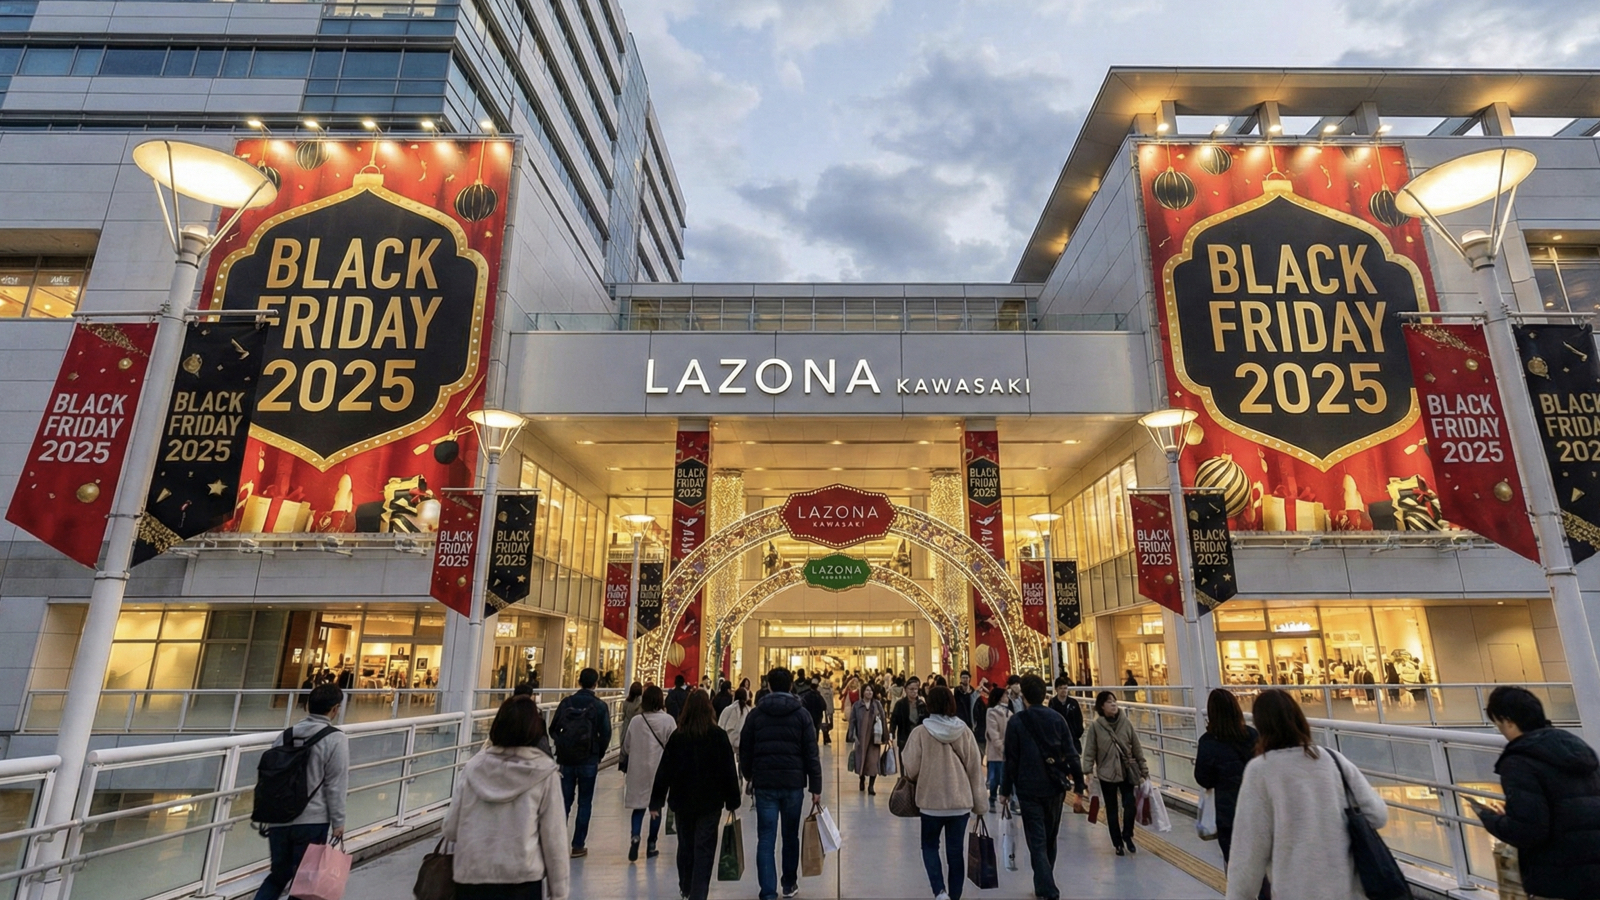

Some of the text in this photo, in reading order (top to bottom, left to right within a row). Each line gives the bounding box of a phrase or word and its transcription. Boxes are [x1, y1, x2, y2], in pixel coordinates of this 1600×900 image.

[266, 238, 442, 289] BLACK
[1208, 243, 1378, 295] BLACK
[1209, 300, 1386, 353] FRIDAY
[645, 358, 1030, 395] LAZONA KAWASAKI
[257, 359, 416, 412] 2025
[1233, 362, 1388, 415] 2025
[53, 393, 128, 415] BLACK
[173, 391, 243, 413] BLACK
[1427, 394, 1496, 416] BLACK
[43, 415, 125, 439] FRIDAY
[168, 413, 243, 437] FRIDAY
[1431, 416, 1501, 439] FRIDAY
[1545, 416, 1600, 437] FRIDA
[38, 441, 110, 464] 2025
[166, 439, 231, 462] 2025
[1441, 441, 1504, 463] 2025
[1556, 440, 1600, 461] 202
[677, 468, 705, 478] BLACK
[970, 468, 998, 478] BLACK
[676, 478, 705, 488] FRIDAY
[970, 478, 998, 487] FRIDAY
[678, 489, 702, 497] 2025
[973, 488, 996, 497] 2025
[798, 506, 878, 519] LAZONA
[440, 531, 473, 542] BLACK
[497, 531, 530, 542] BLACK
[1137, 529, 1171, 541] BLACK
[1193, 529, 1226, 541] BLACK
[438, 542, 473, 554] FRIDAY
[495, 542, 530, 553] FRIDAY
[1138, 542, 1171, 552] FRIDAY
[1194, 542, 1227, 552] FRIDAY
[438, 555, 469, 567] 2025
[496, 555, 527, 566] 2025
[1141, 554, 1172, 565] 2025
[1197, 554, 1228, 565] 2025
[812, 566, 862, 574] LAZONA
